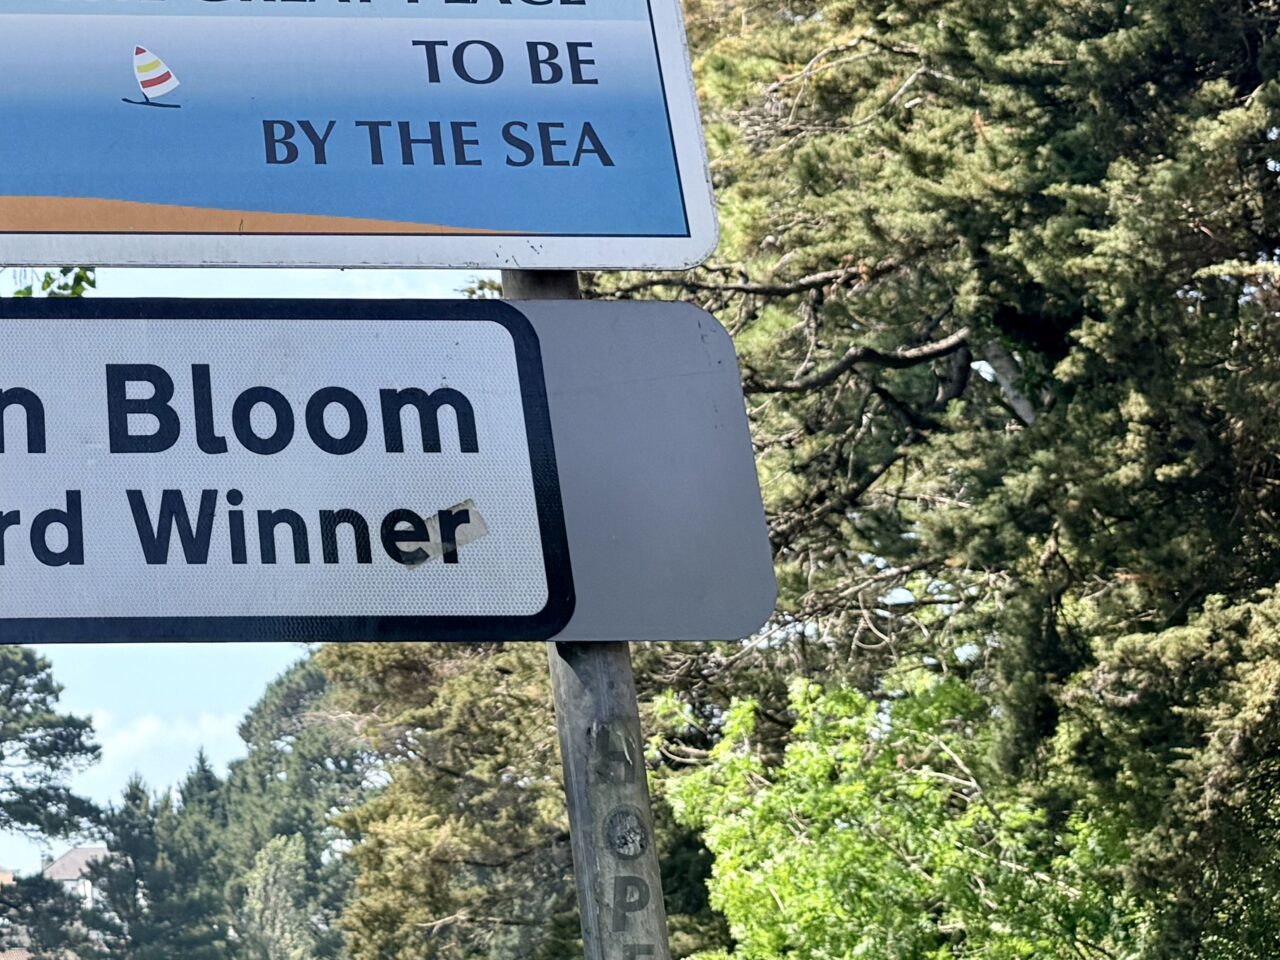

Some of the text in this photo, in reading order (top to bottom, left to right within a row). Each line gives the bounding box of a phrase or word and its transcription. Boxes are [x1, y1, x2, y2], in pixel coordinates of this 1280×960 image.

[412, 40, 599, 85] TO BE
[263, 120, 616, 167] BY THE SEA
[106, 364, 480, 456] Bloom
[126, 489, 471, 566] Winner
